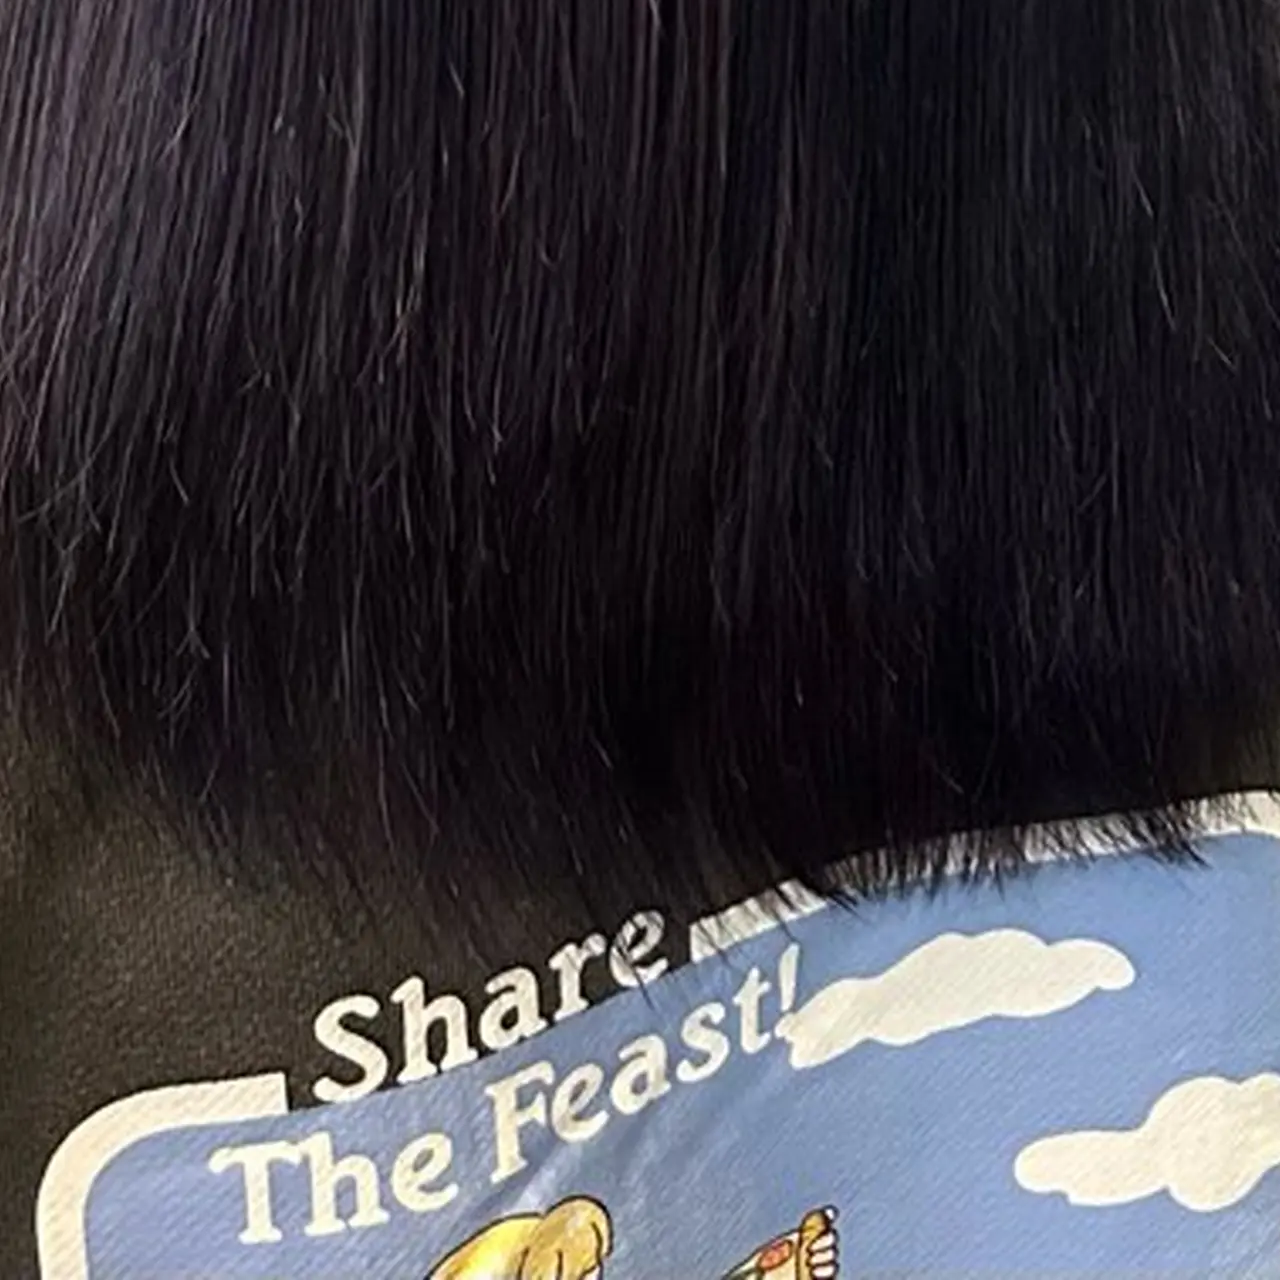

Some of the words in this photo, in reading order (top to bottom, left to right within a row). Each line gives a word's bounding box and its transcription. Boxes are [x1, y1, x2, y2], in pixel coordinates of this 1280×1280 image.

[208, 1131, 460, 1244] The
[486, 942, 802, 1186] Feast!
[312, 908, 670, 1104] Share
